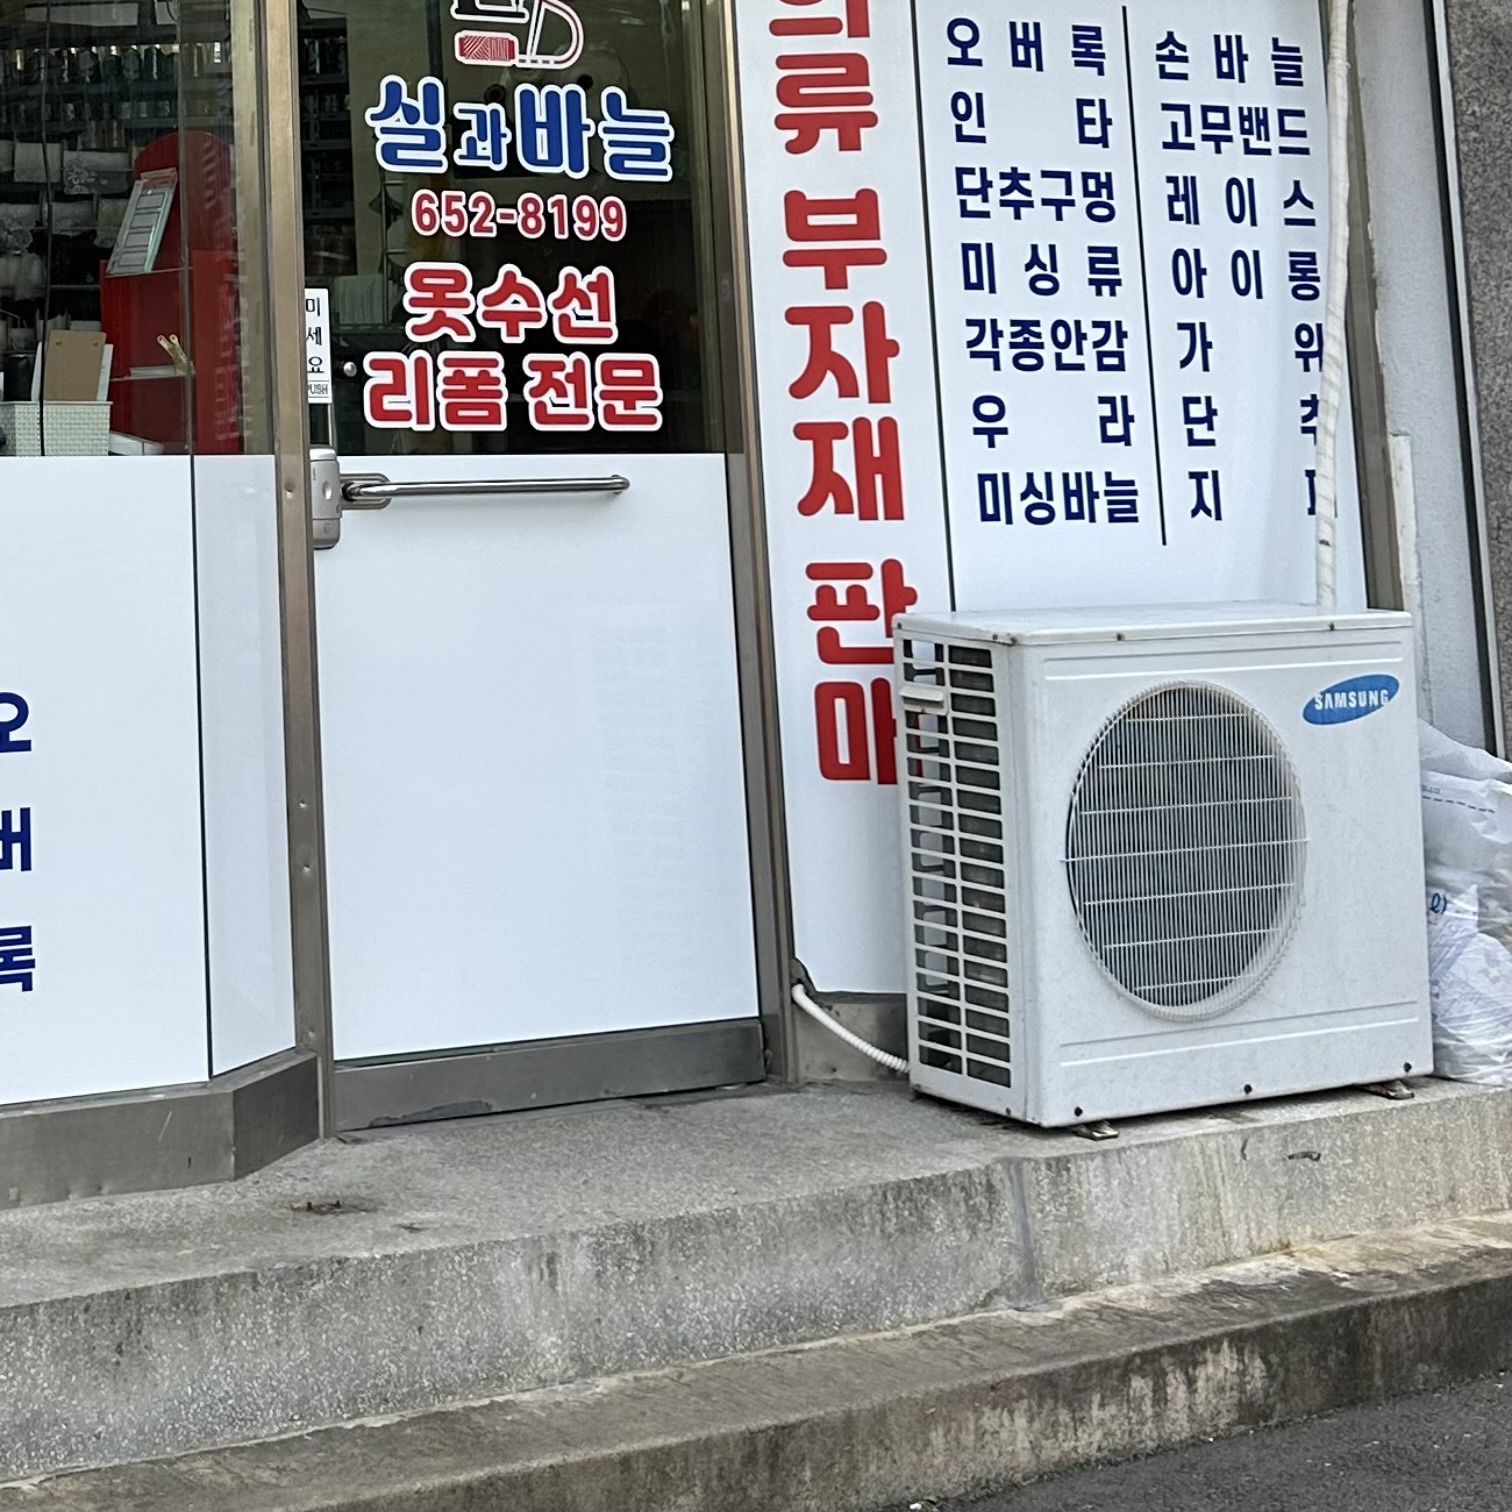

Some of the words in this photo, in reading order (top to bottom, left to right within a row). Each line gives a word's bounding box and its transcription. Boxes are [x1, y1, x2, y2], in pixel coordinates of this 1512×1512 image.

[1161, 101, 1311, 158] 고무밴드
[414, 191, 626, 240] 652-8199
[955, 166, 1117, 225] 단추구멍
[407, 266, 615, 341] 옷수선
[782, 187, 905, 522] 부자재
[966, 316, 1129, 375] 각종안감
[366, 353, 505, 429] 리폼
[527, 356, 662, 429] 전문
[978, 469, 1140, 526] 미싱바늘
[1314, 689, 1389, 710] SAMSUNG
